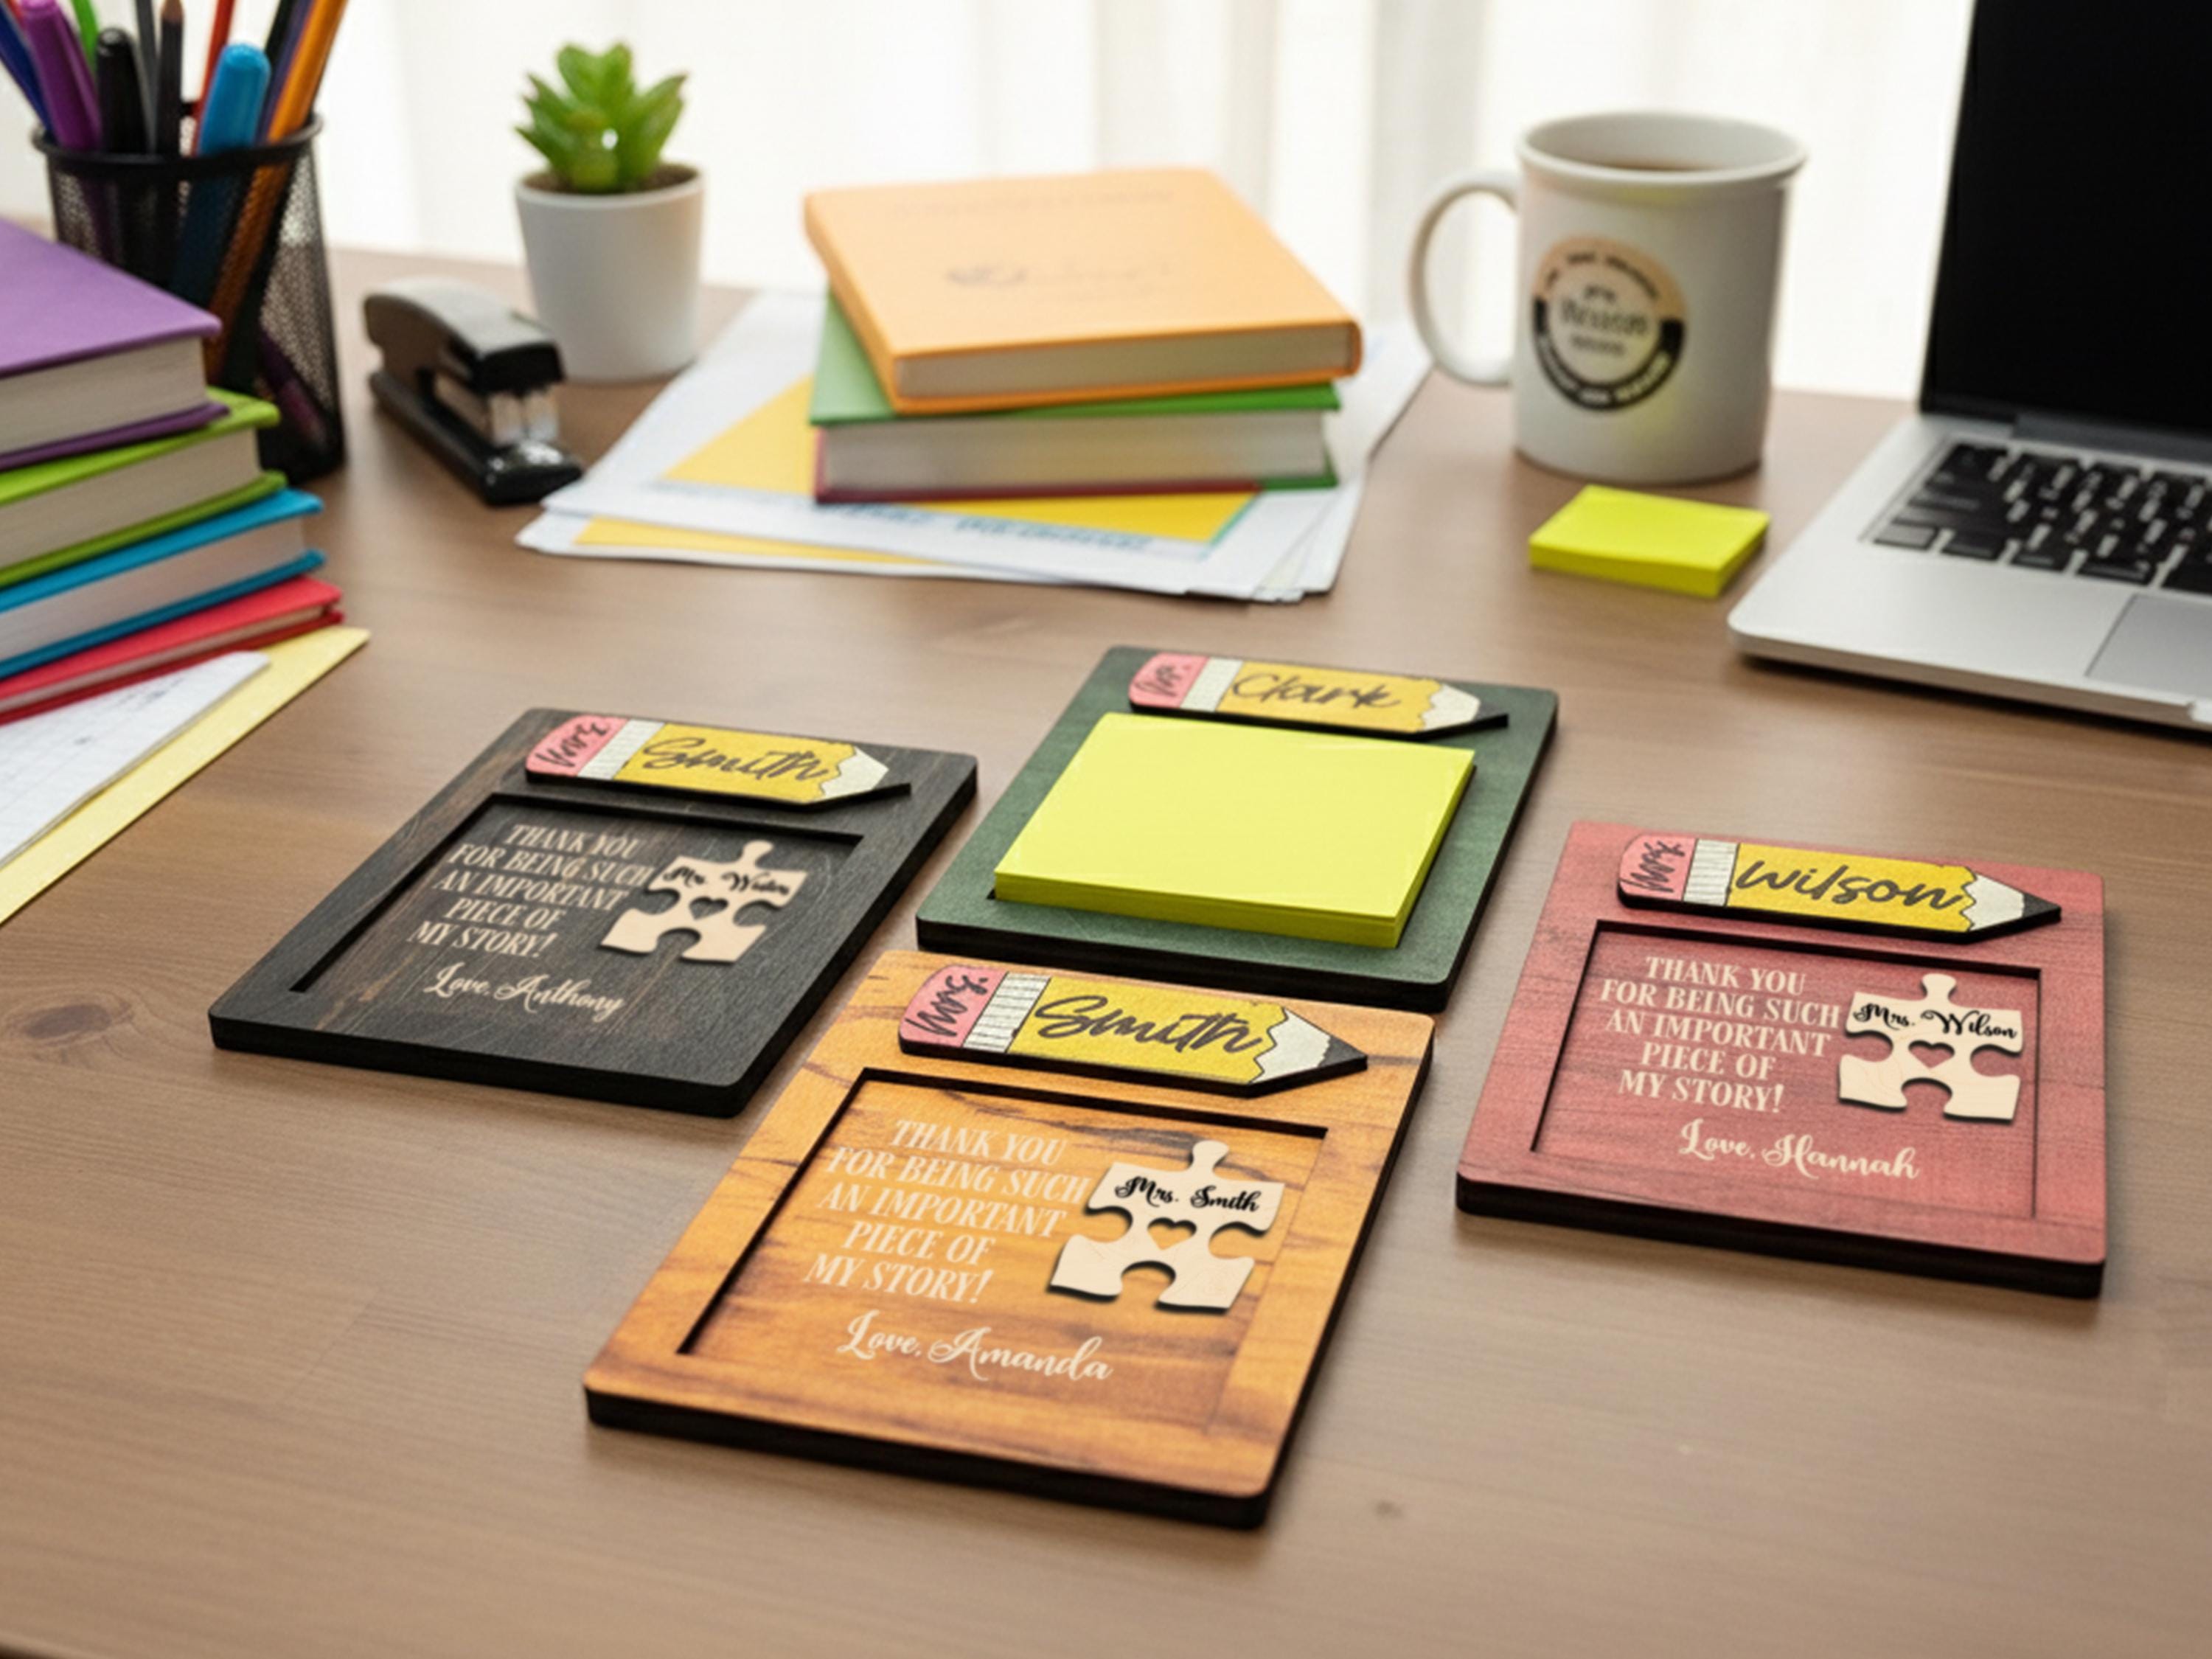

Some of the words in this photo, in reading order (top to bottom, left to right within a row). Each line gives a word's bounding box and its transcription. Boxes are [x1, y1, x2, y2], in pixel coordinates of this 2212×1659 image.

[1233, 673, 1402, 709] Clark
[642, 737, 830, 782] Smith
[504, 824, 593, 853] THANK
[590, 834, 641, 860] YOU
[448, 844, 506, 869] FOR
[503, 850, 587, 879] BEING
[582, 860, 655, 887] SUCH
[432, 869, 478, 893] AN
[473, 873, 629, 912] IMPORTANT
[444, 897, 527, 926] PIECE
[524, 907, 566, 931] OF
[406, 921, 460, 946] MY
[452, 927, 558, 959] STORY!
[493, 974, 625, 1023] Anthony
[1646, 956, 1747, 989] THANK
[1748, 968, 1807, 996] YOU
[1034, 994, 1263, 1054] Smith
[1600, 979, 1657, 1007] FOR
[1666, 987, 1755, 1019] BEING
[1763, 998, 1841, 1029] SUCH
[1852, 1003, 1916, 1031] Mrs.
[1920, 1009, 2017, 1039] Wilson
[1605, 1009, 1646, 1034] AN
[1654, 1013, 1832, 1058] IMPORTANT
[1641, 1041, 1725, 1076] PIECE
[1735, 1053, 1777, 1081] OF
[1618, 1069, 1668, 1099] MY
[1672, 1076, 1785, 1113] STORY!
[888, 1119, 998, 1165] THANK
[1000, 1133, 1068, 1166] YOU
[1761, 1134, 1919, 1180] Hannah
[825, 1146, 894, 1180] FOR
[896, 1155, 1002, 1194] BEING
[1003, 1168, 1093, 1206] SUCH
[1114, 1175, 1180, 1208] Mrs.
[1189, 1185, 1262, 1213] Smith
[816, 1181, 872, 1213] AN
[869, 1188, 1068, 1239] IMPORTANT
[841, 1220, 944, 1262] PIECE
[945, 1234, 997, 1267] OF
[803, 1252, 864, 1287] MY
[861, 1260, 994, 1304] STORY!
[927, 1326, 1114, 1382] Amanda
